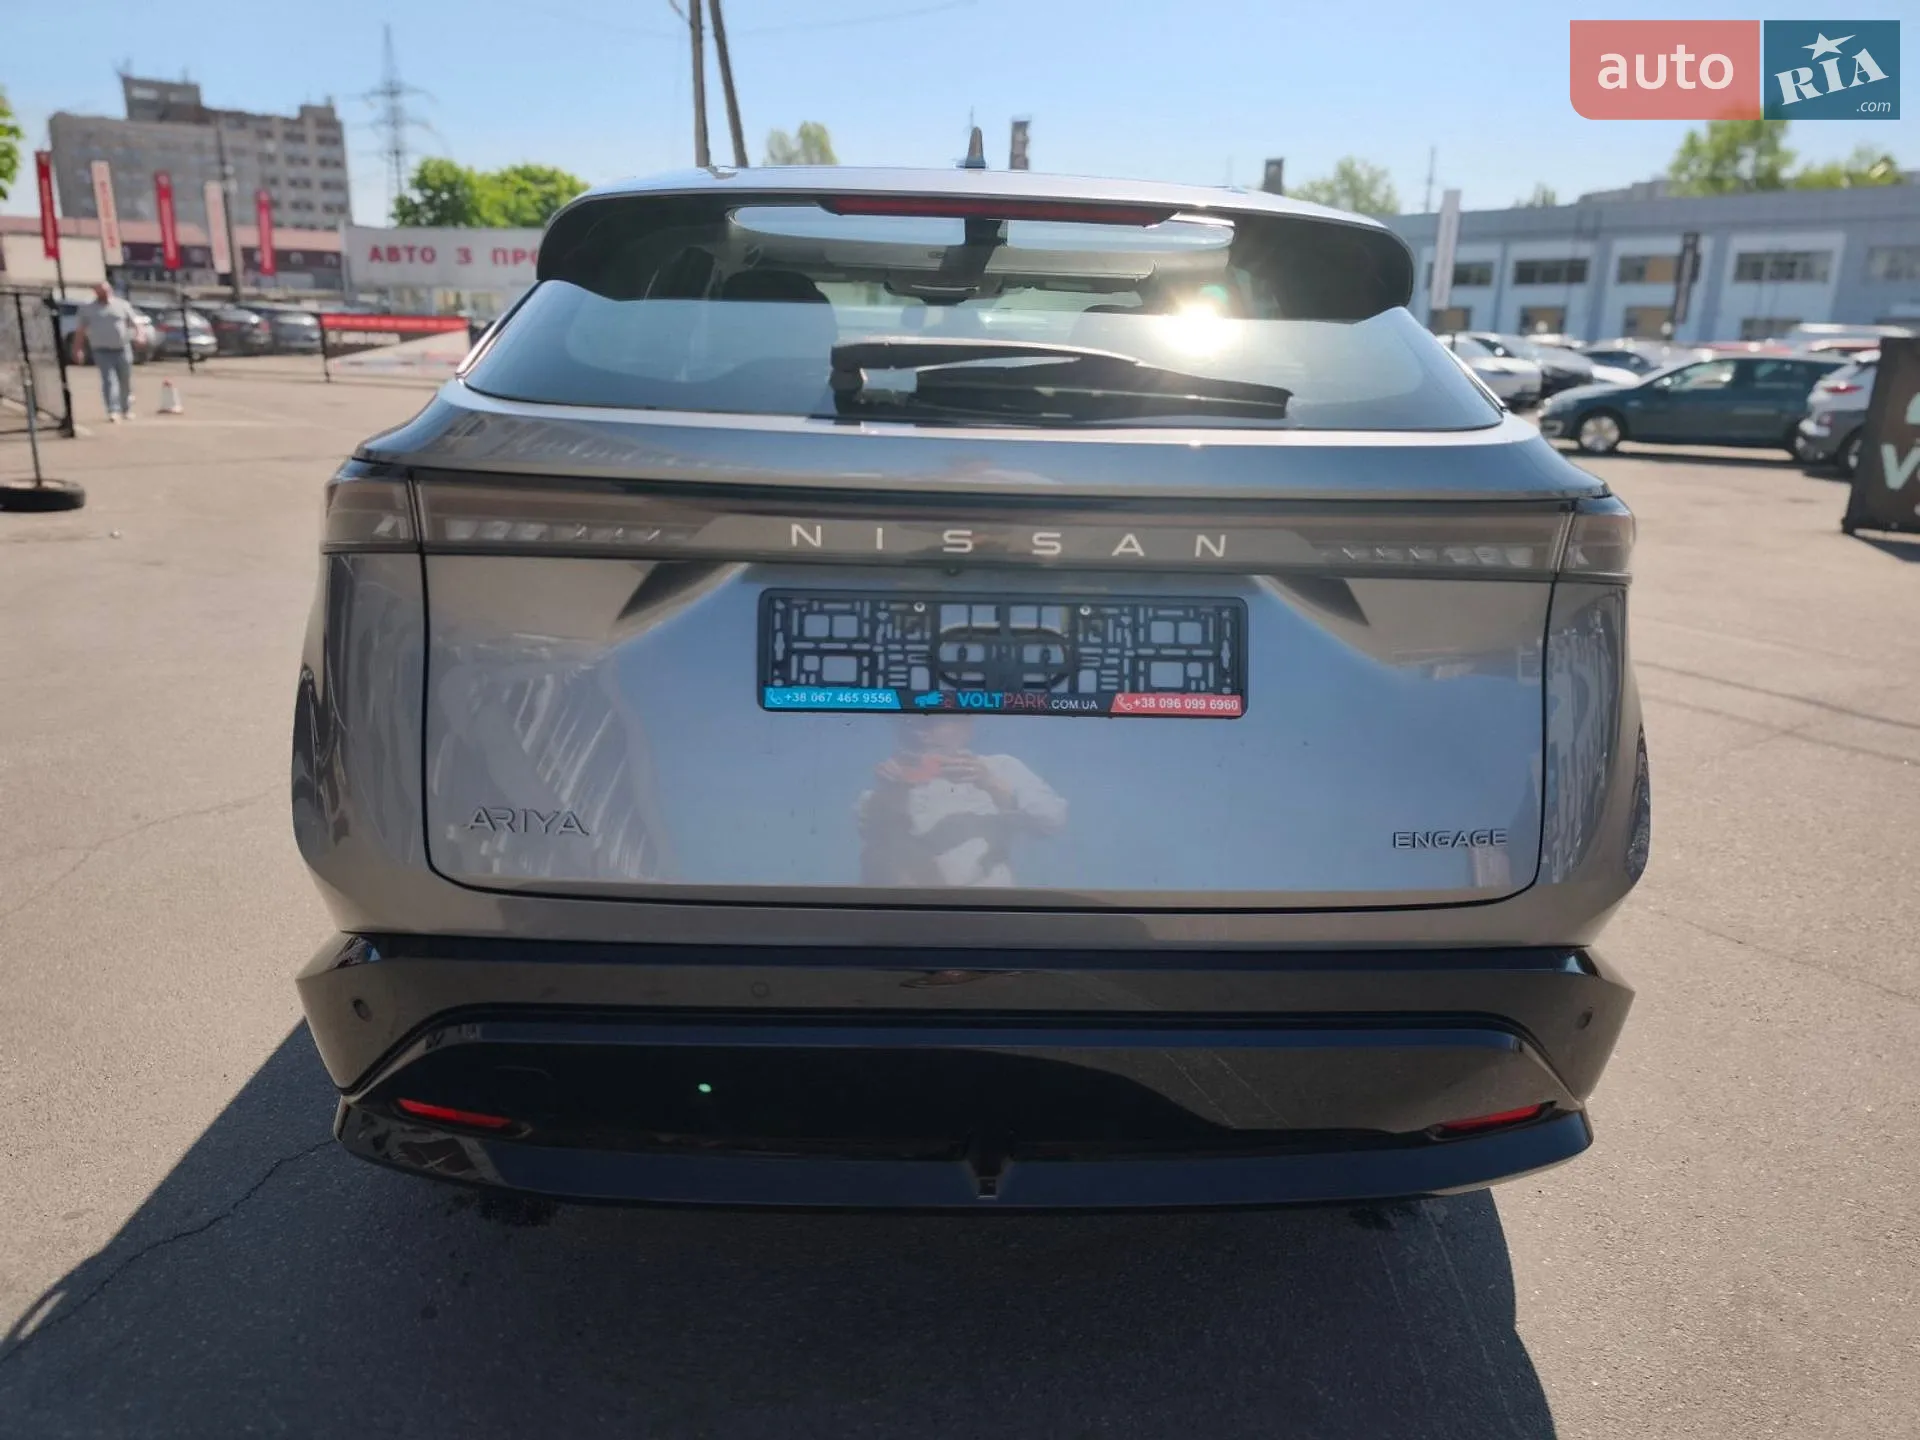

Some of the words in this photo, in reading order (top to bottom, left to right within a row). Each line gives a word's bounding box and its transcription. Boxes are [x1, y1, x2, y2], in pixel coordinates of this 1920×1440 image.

[369, 245, 436, 265] АВТО
[790, 523, 1227, 558] NISSAN
[785, 692, 807, 703] +38
[811, 692, 833, 703] 067
[836, 692, 859, 704] 465
[862, 693, 893, 705] 9556
[1134, 697, 1156, 709] +38
[1159, 698, 1181, 709] 096
[1184, 698, 1206, 710] 099
[1209, 699, 1239, 711] 6960
[469, 805, 590, 836] ARIYA
[1393, 828, 1508, 849] ENGAGE
